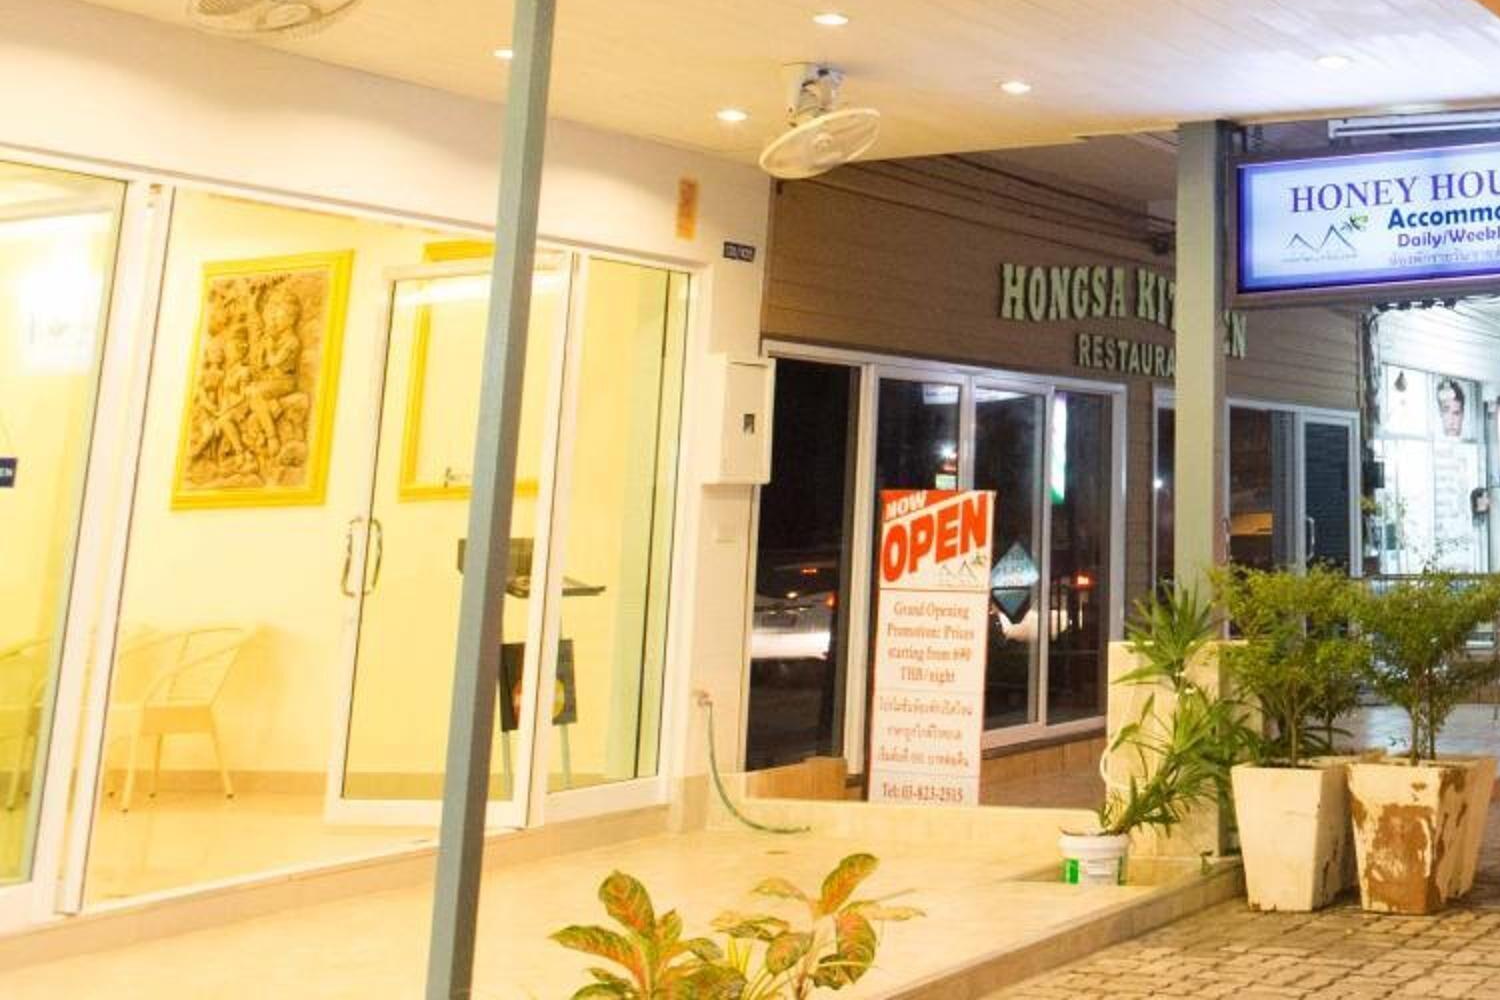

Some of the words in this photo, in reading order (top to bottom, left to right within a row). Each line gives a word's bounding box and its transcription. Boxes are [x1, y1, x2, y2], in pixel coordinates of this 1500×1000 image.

[1290, 175, 1418, 213] HONEY
[1001, 263, 1126, 322] HONGSA
[885, 490, 927, 521] NOW
[881, 493, 988, 583] OPEN
[894, 601, 925, 617] Grand
[926, 601, 969, 620] Opening
[888, 644, 925, 662] starting
